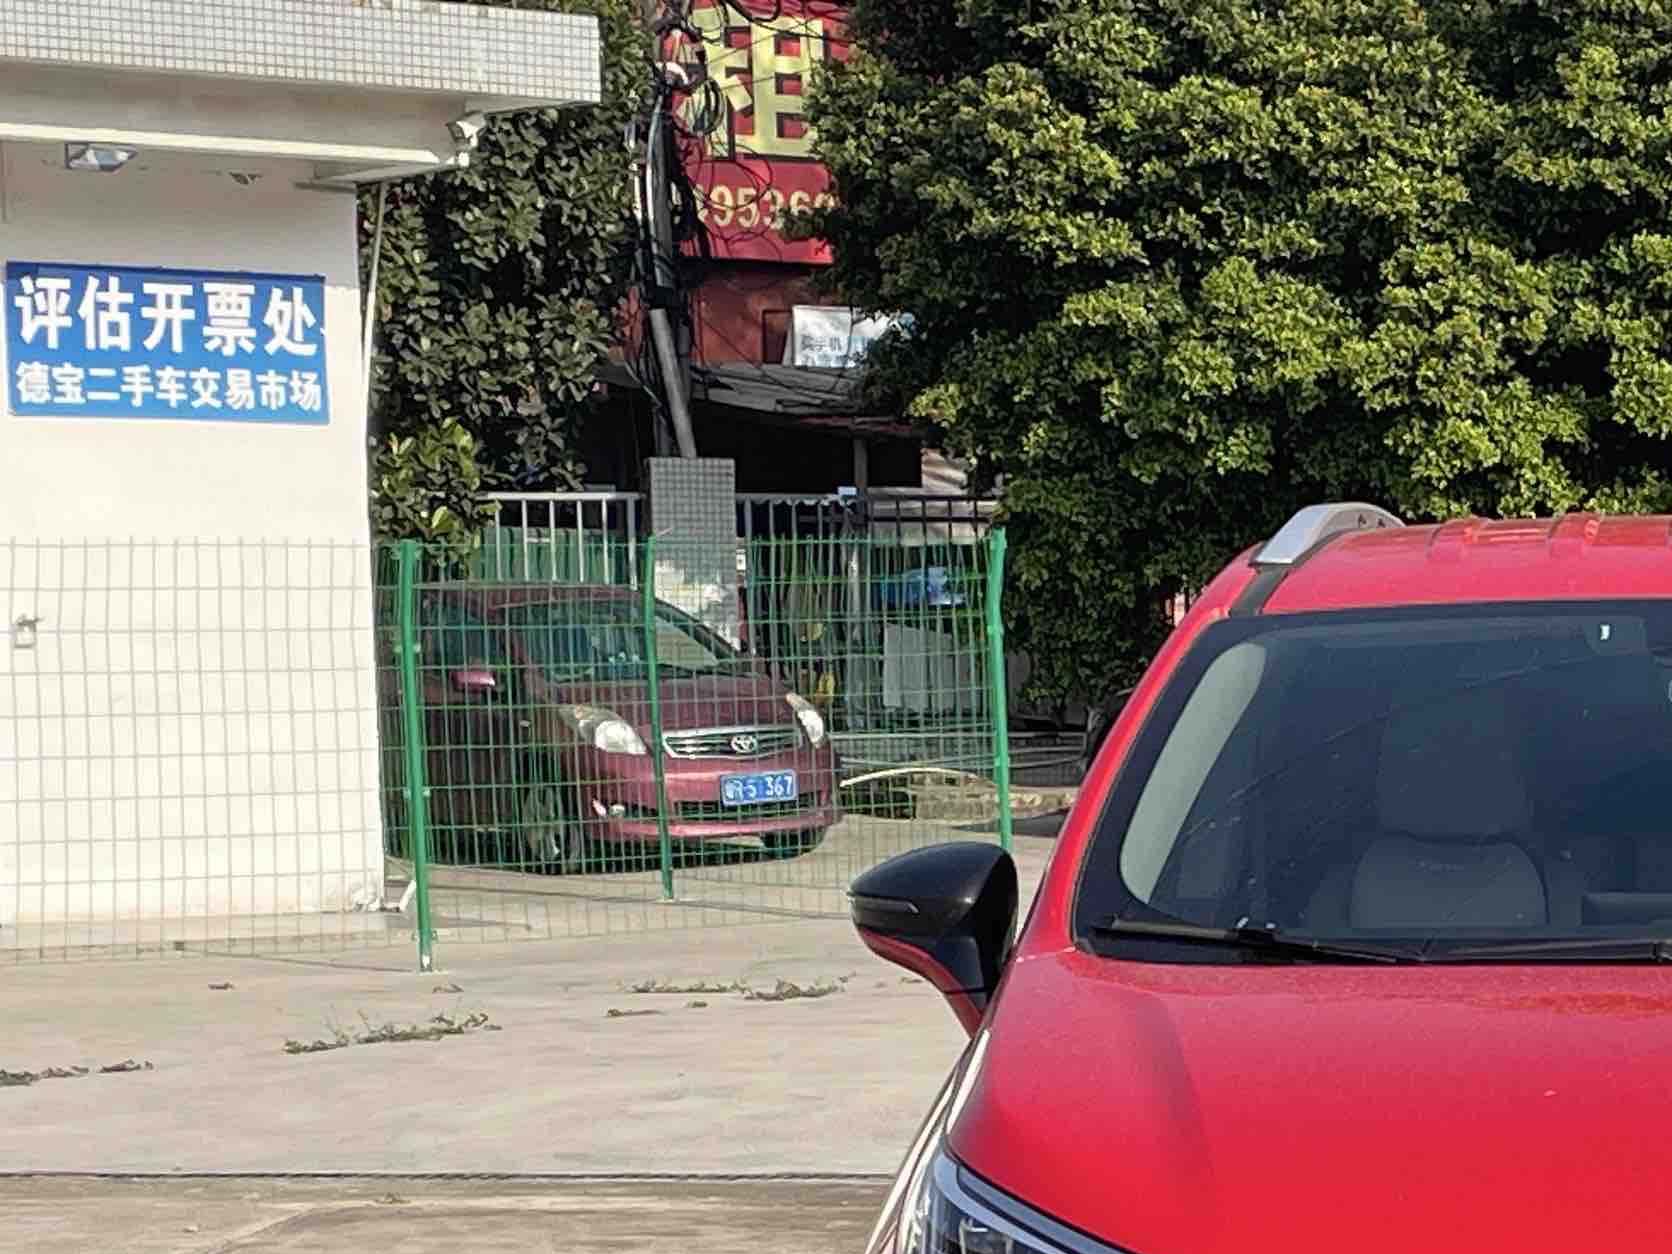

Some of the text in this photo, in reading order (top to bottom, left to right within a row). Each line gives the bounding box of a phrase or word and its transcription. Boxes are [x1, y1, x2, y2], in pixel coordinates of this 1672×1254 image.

[14, 274, 318, 357] 评估开票处
[14, 360, 322, 413] 德宝二手车交易市场
